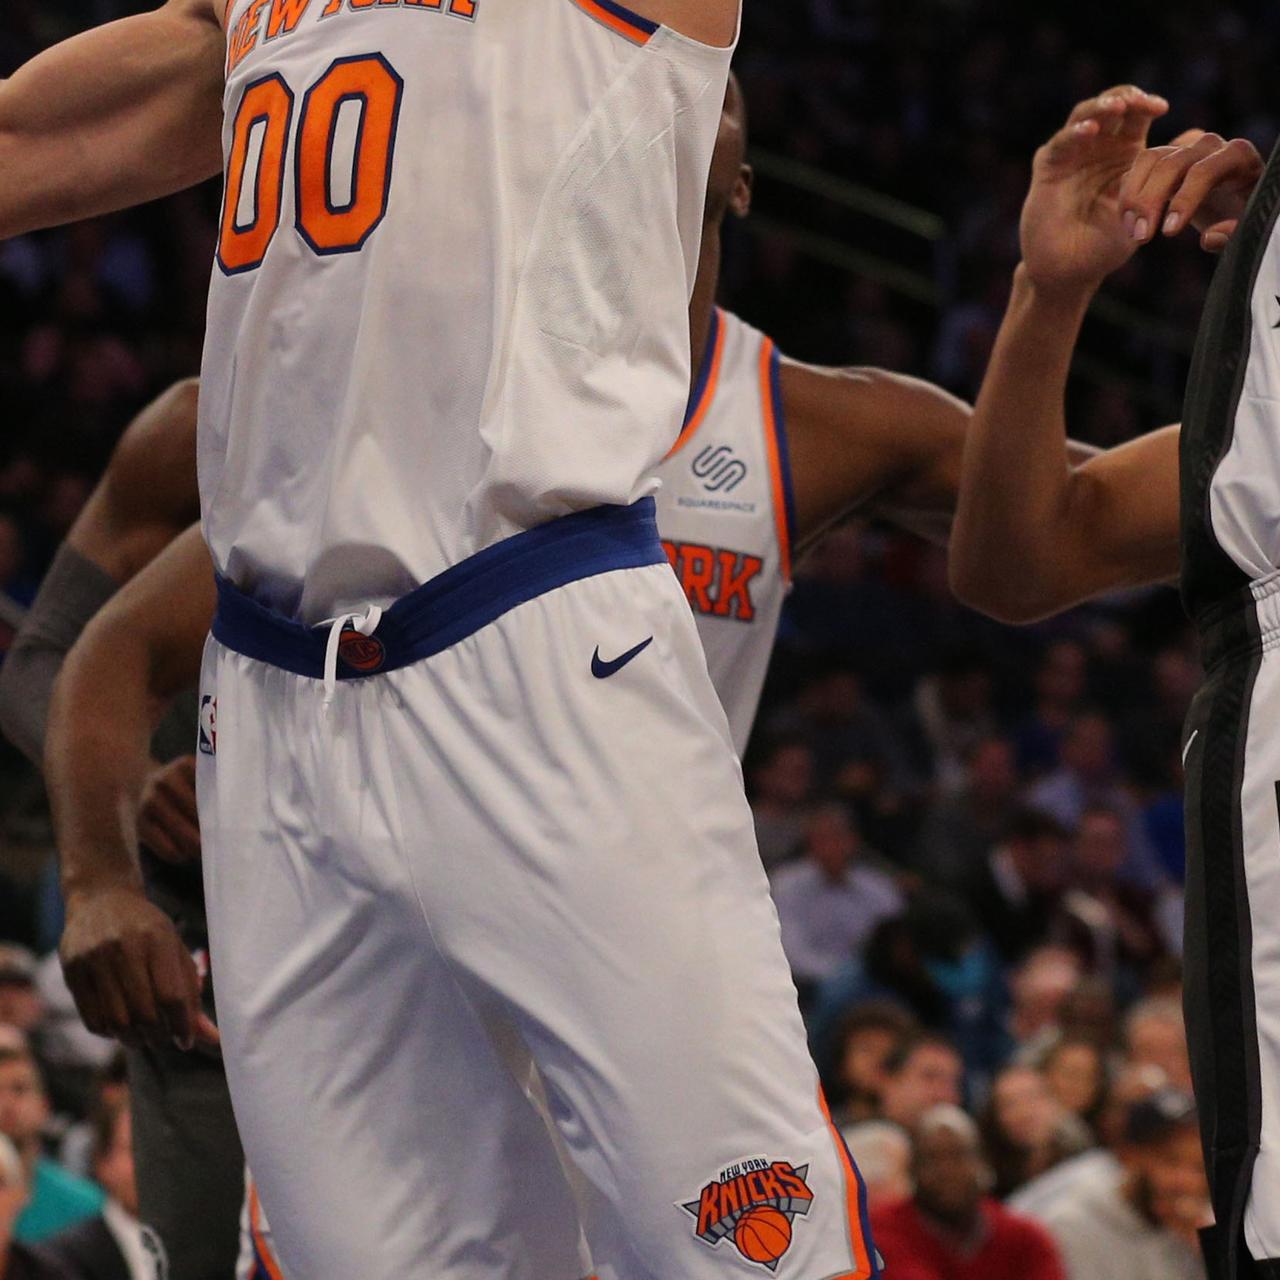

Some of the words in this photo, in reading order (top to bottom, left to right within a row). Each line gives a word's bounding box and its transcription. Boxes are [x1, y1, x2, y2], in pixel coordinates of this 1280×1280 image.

[216, 51, 405, 277] 00
[695, 1161, 815, 1244] KNICKS
[719, 1165, 742, 1183] NEW
[741, 1157, 769, 1175] YORK
